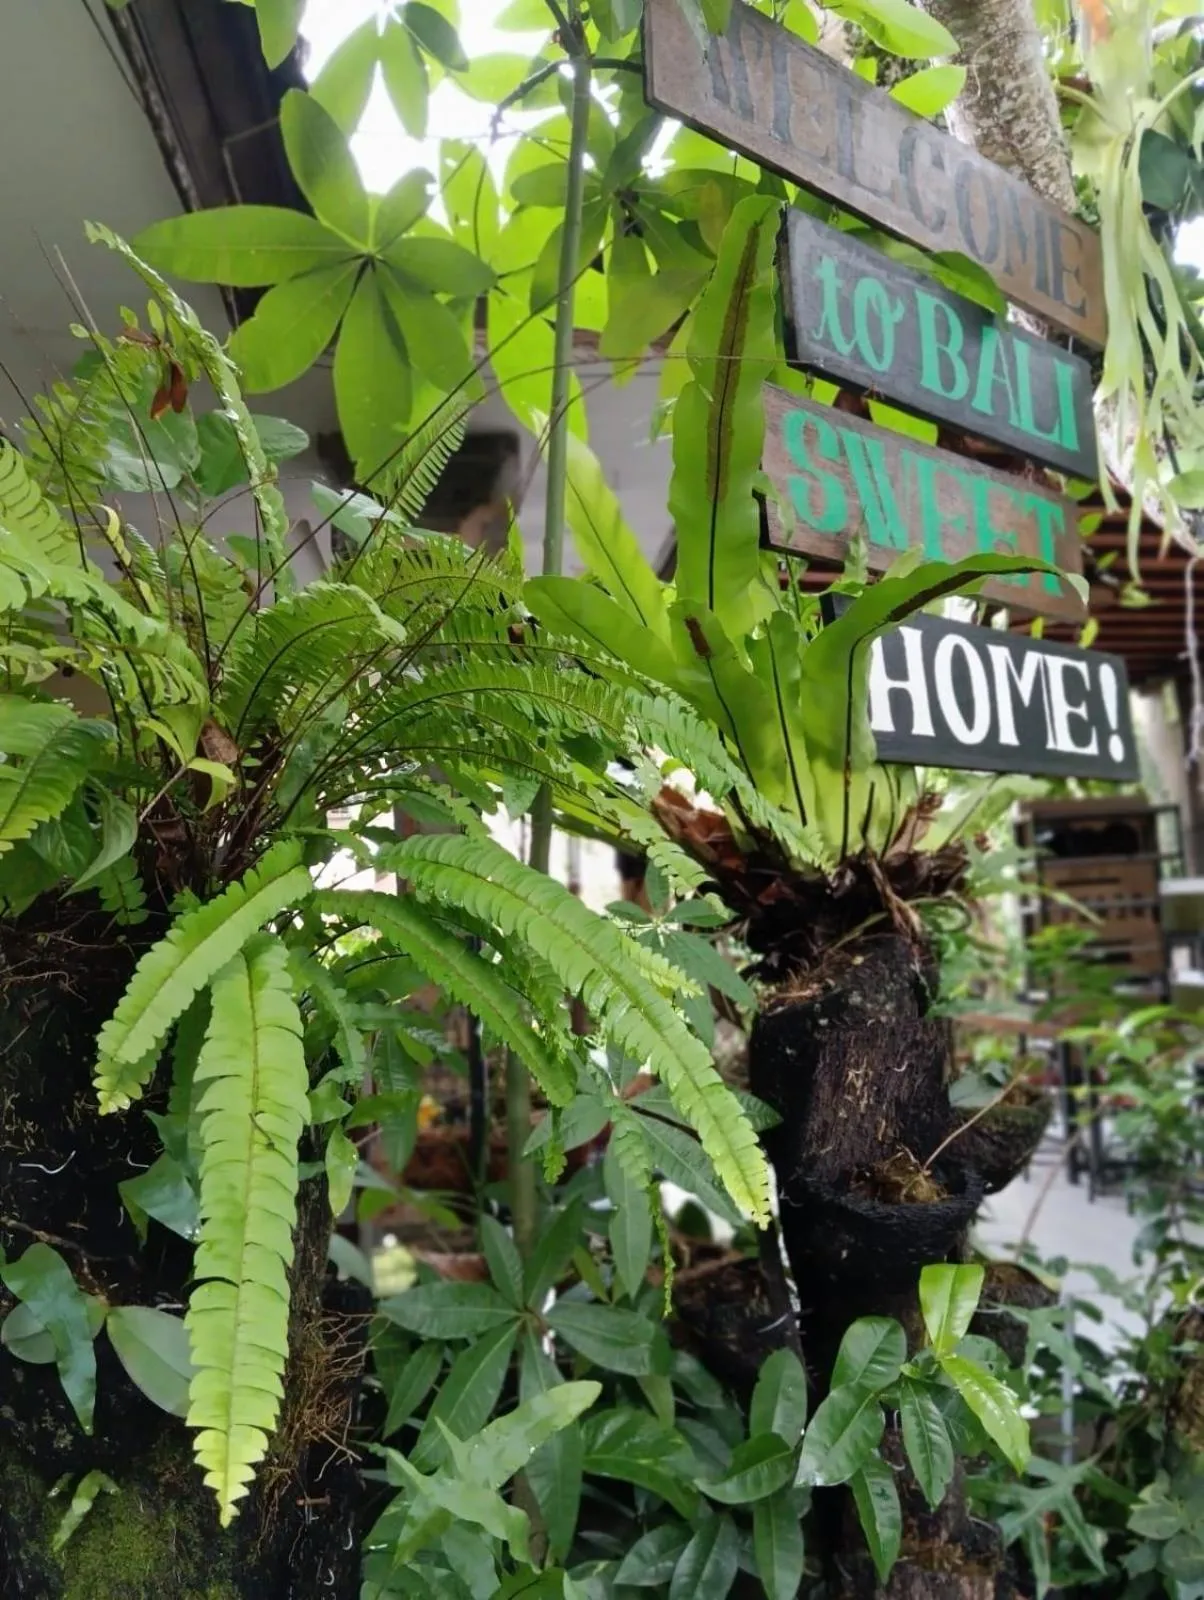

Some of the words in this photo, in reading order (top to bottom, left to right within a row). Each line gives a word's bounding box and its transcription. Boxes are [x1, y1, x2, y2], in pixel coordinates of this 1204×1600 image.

[705, 8, 1087, 318] WELCOME
[814, 254, 904, 372] to
[915, 288, 1080, 452] BALI
[782, 409, 1065, 597] SWEET
[868, 626, 1125, 763] HOME!
